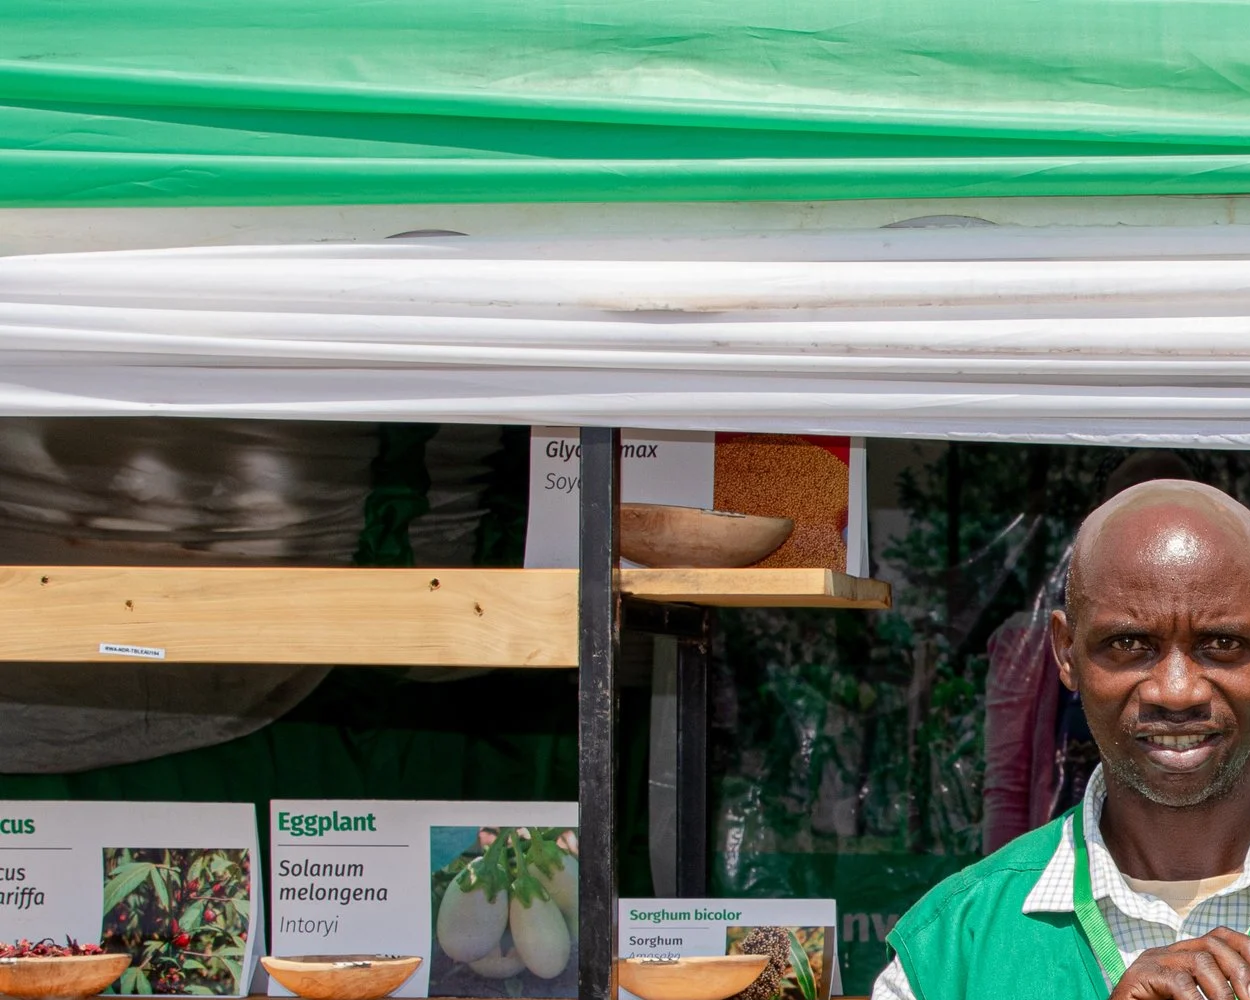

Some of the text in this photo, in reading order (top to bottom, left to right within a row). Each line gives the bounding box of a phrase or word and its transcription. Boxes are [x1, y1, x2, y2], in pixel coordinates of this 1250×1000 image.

[546, 440, 658, 462] Glyc max
[0, 818, 35, 834] cus
[278, 811, 376, 836] Eggplant
[278, 859, 364, 878] Solanum
[279, 883, 388, 905] melongena
[279, 915, 339, 937] Intoryi
[629, 908, 742, 924] Sorghum bicolor
[629, 935, 683, 947] Sorghum
